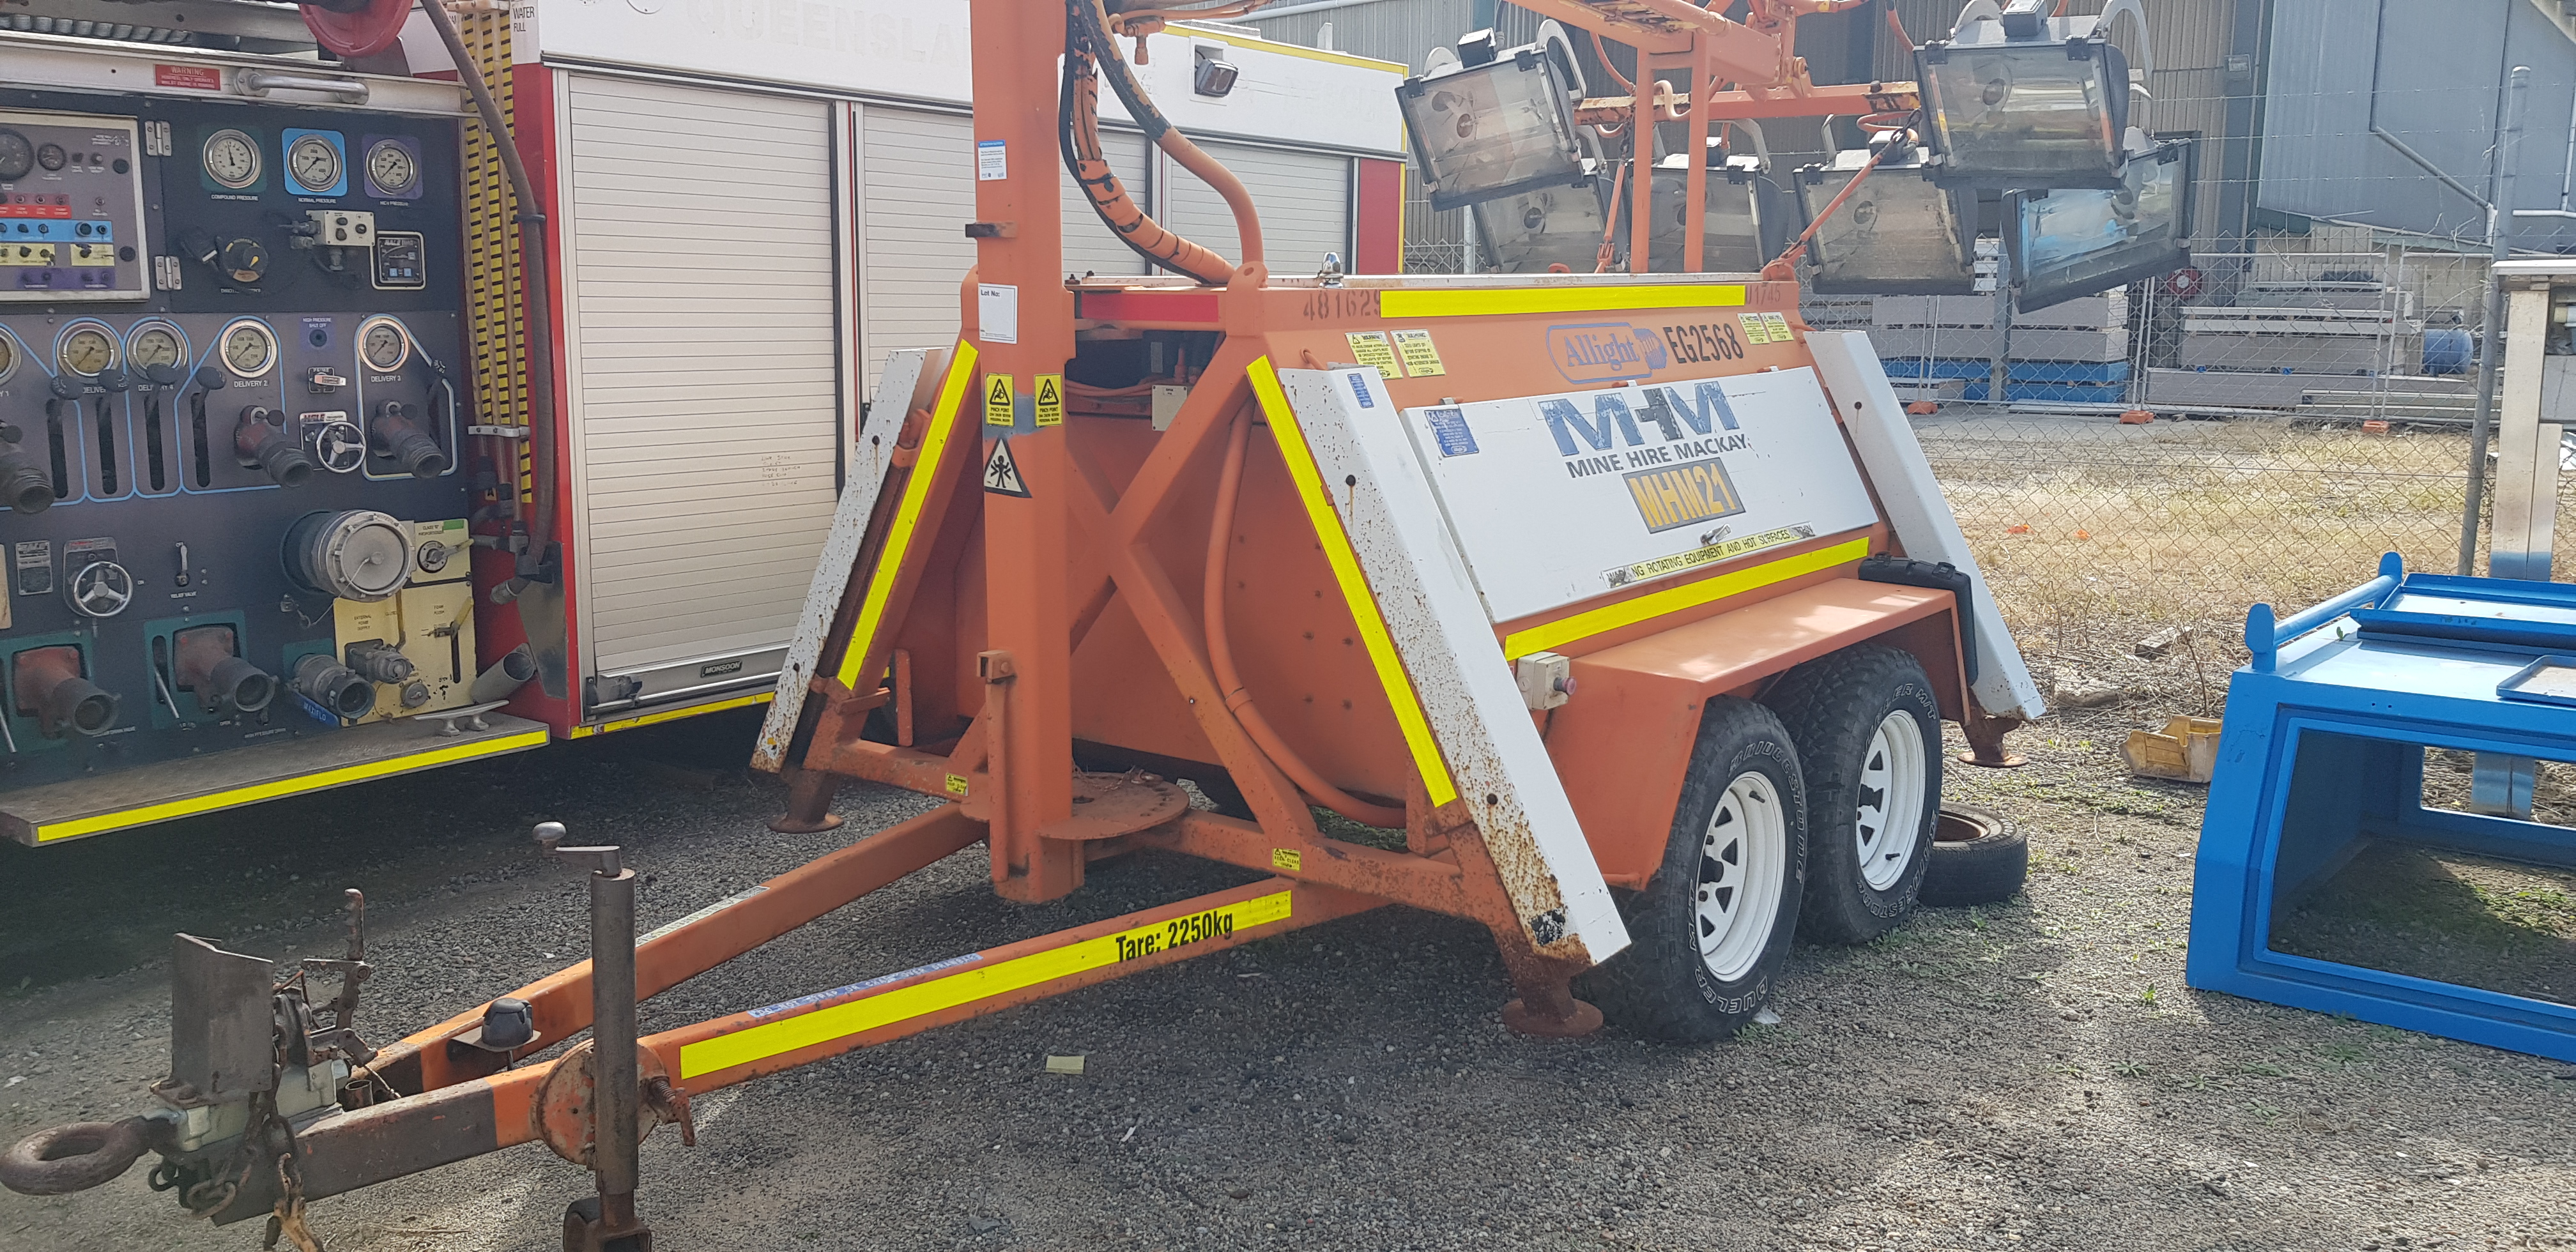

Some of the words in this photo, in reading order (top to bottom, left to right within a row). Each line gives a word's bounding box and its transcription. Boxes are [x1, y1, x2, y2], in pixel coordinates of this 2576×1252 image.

[512, 6, 535, 19] WATER
[514, 23, 526, 32] FULL
[171, 66, 204, 76] WARNING
[1564, 333, 1640, 371] Allight
[1663, 323, 1744, 364] EG2568
[1565, 454, 1623, 478] MINE
[1626, 447, 1673, 468] HIRE
[1673, 434, 1748, 459] MACKAY
[1629, 463, 1736, 528] MHM21
[1646, 556, 1683, 574] ROTATING
[1684, 546, 1724, 564] EQUIPMENT
[1726, 541, 1742, 554] AND
[1744, 537, 1757, 549] HOT
[1758, 529, 1790, 544] SURFACES
[705, 662, 740, 675] MONSOON
[1728, 741, 1805, 884] BRIDGESTONE
[1116, 933, 1161, 963] Tare:
[1168, 910, 1233, 949] 2250kg
[845, 985, 861, 993] OR
[902, 968, 925, 978] OVER
[1694, 966, 1768, 1014] DUELER
